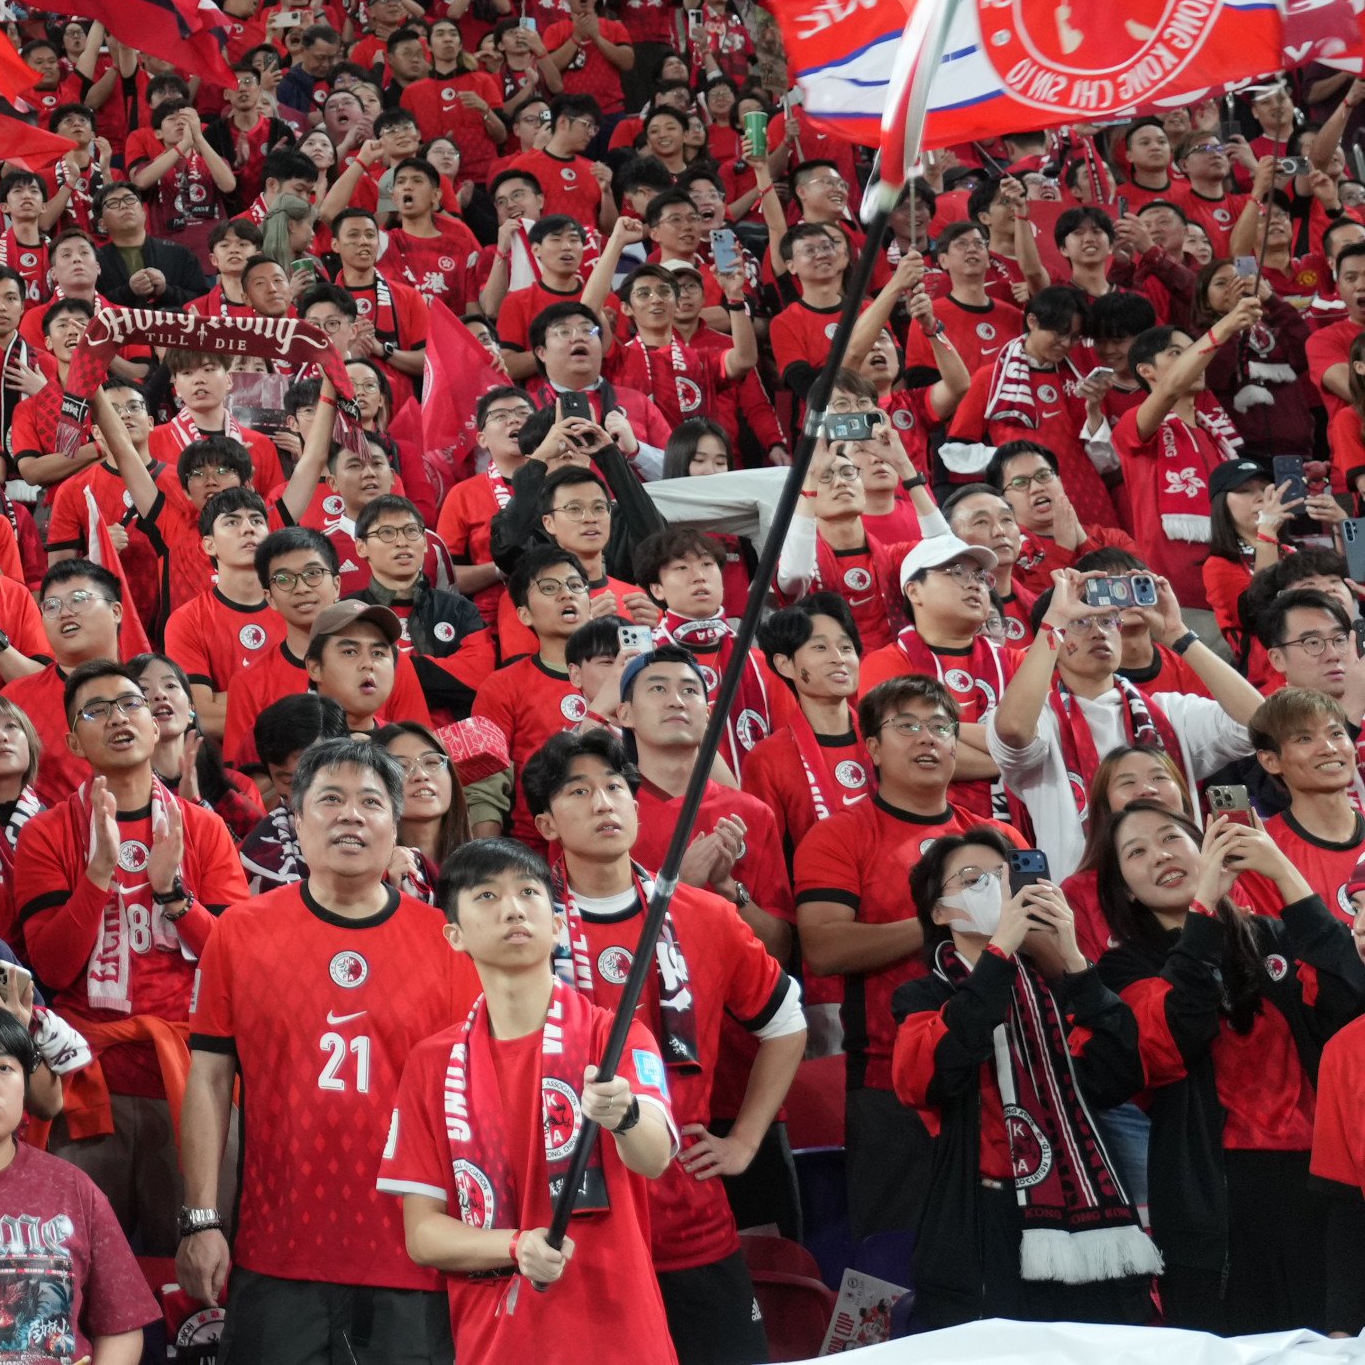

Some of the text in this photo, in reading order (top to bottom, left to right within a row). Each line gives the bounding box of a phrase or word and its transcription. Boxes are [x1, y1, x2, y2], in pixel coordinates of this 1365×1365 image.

[144, 333, 249, 351] TILL DIE
[317, 1031, 371, 1095] 21
